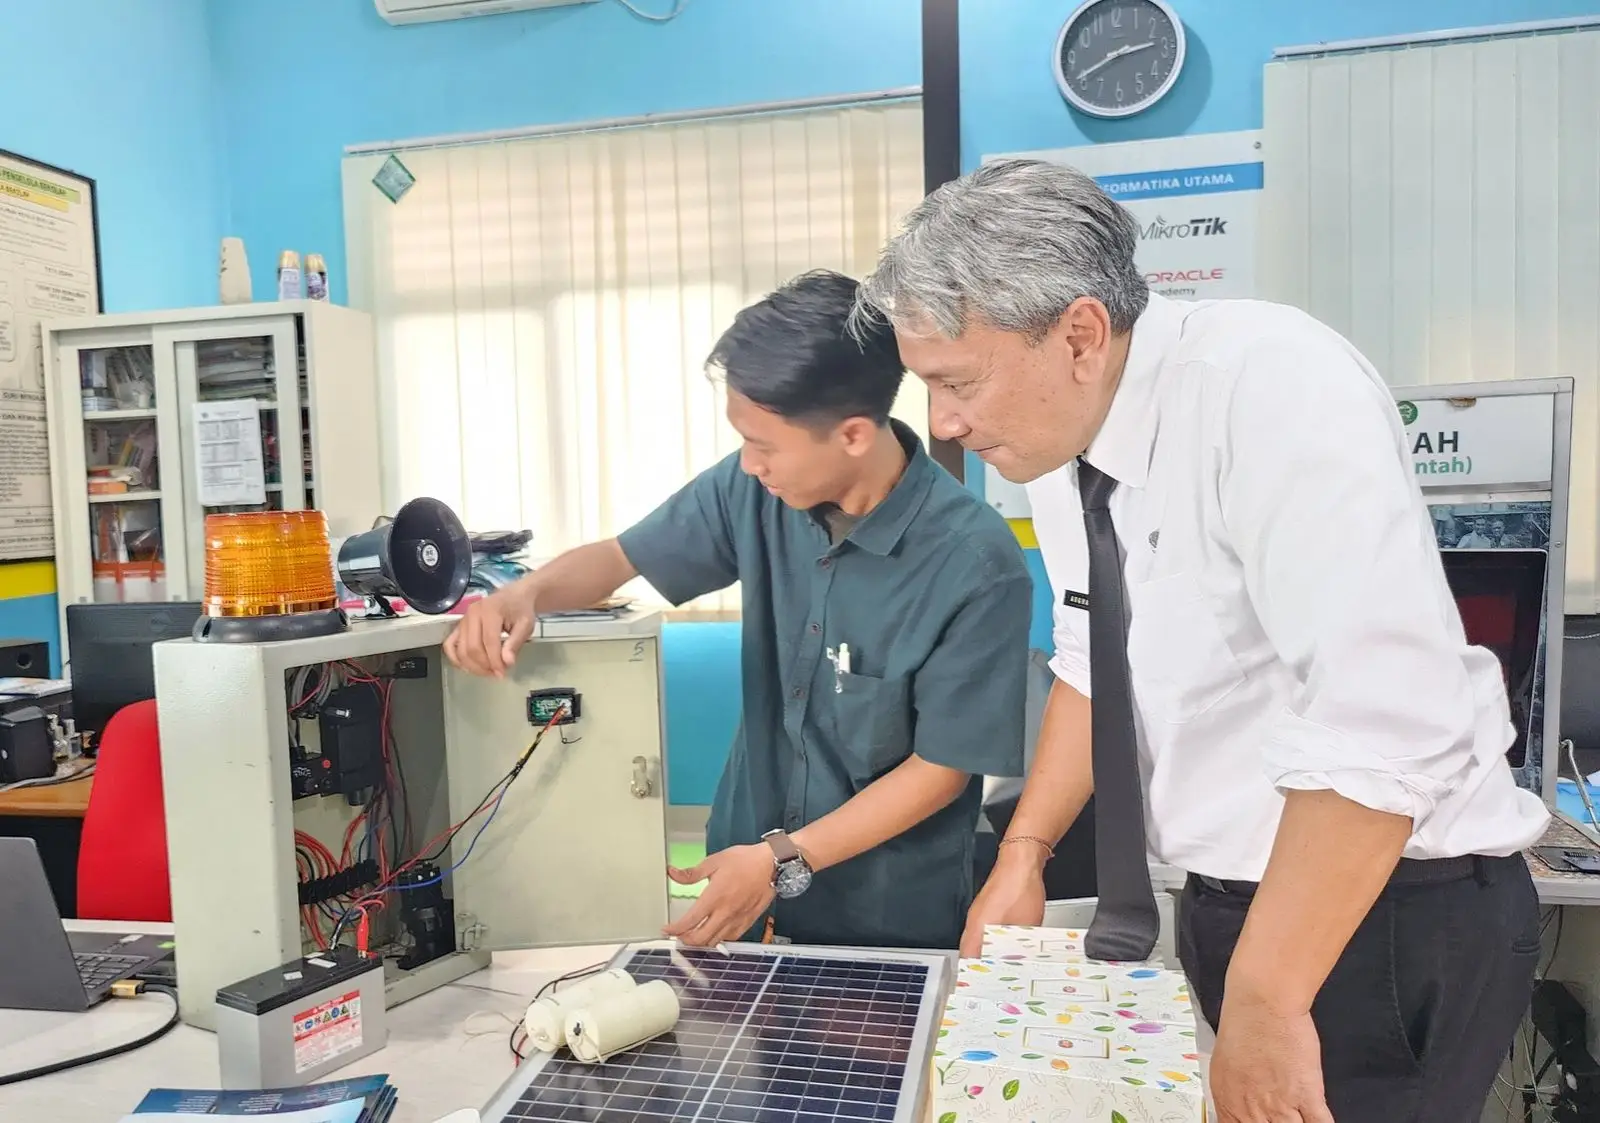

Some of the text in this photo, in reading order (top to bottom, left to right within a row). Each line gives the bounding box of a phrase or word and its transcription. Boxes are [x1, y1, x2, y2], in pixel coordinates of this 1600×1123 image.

[1149, 17, 1156, 39] 2
[1160, 37, 1169, 58] 3
[1067, 50, 1076, 71] 9
[1150, 59, 1159, 80] 4
[1114, 81, 1124, 102] 6
[1135, 72, 1144, 94] 5
[1100, 173, 1235, 194] FORMATIKA UTAMA
[1144, 268, 1225, 284] ORACLE
[1412, 430, 1459, 454] AH
[1415, 456, 1472, 475] ntah)
